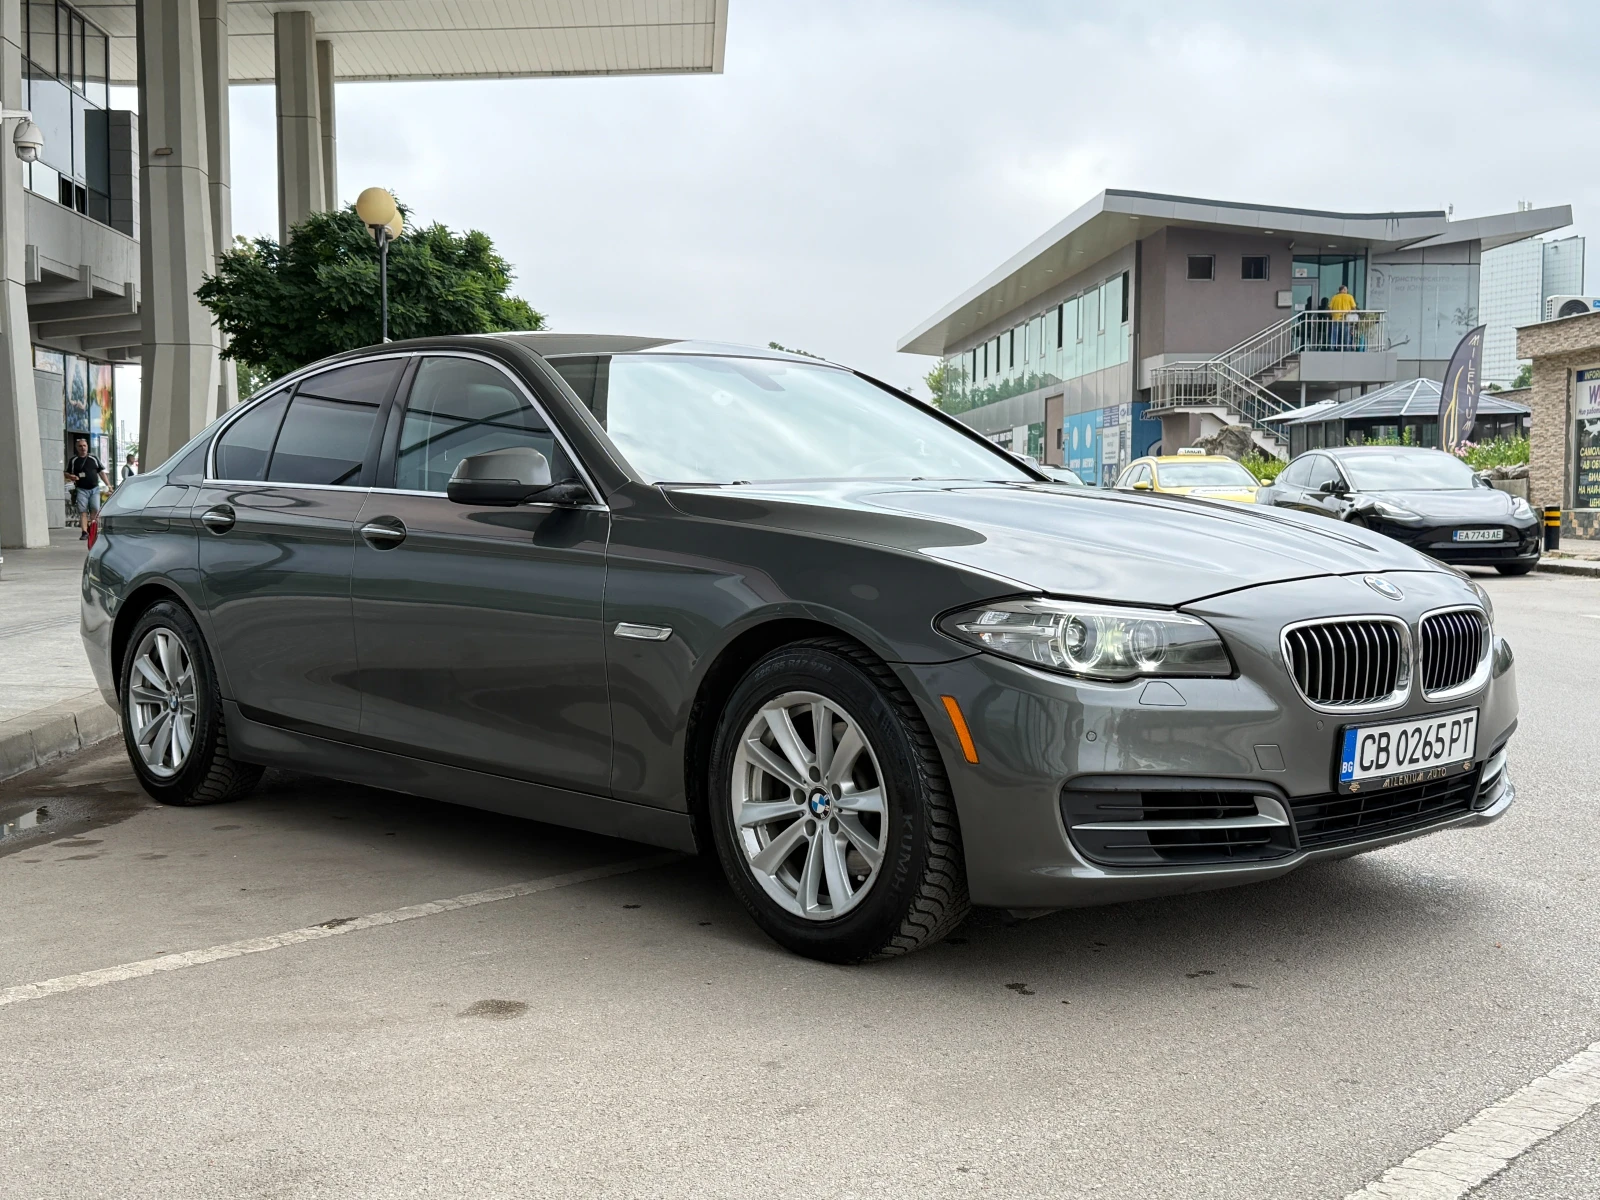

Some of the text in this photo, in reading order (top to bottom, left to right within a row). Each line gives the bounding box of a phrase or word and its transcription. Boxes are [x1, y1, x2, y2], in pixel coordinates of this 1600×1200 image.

[1462, 335, 1480, 431] MILENIUM
[1471, 531, 1490, 540] 7743
[1359, 716, 1474, 771] CB 0265 PT
[1342, 761, 1353, 774] BG
[1383, 767, 1447, 788] MILENIUM AUTO
